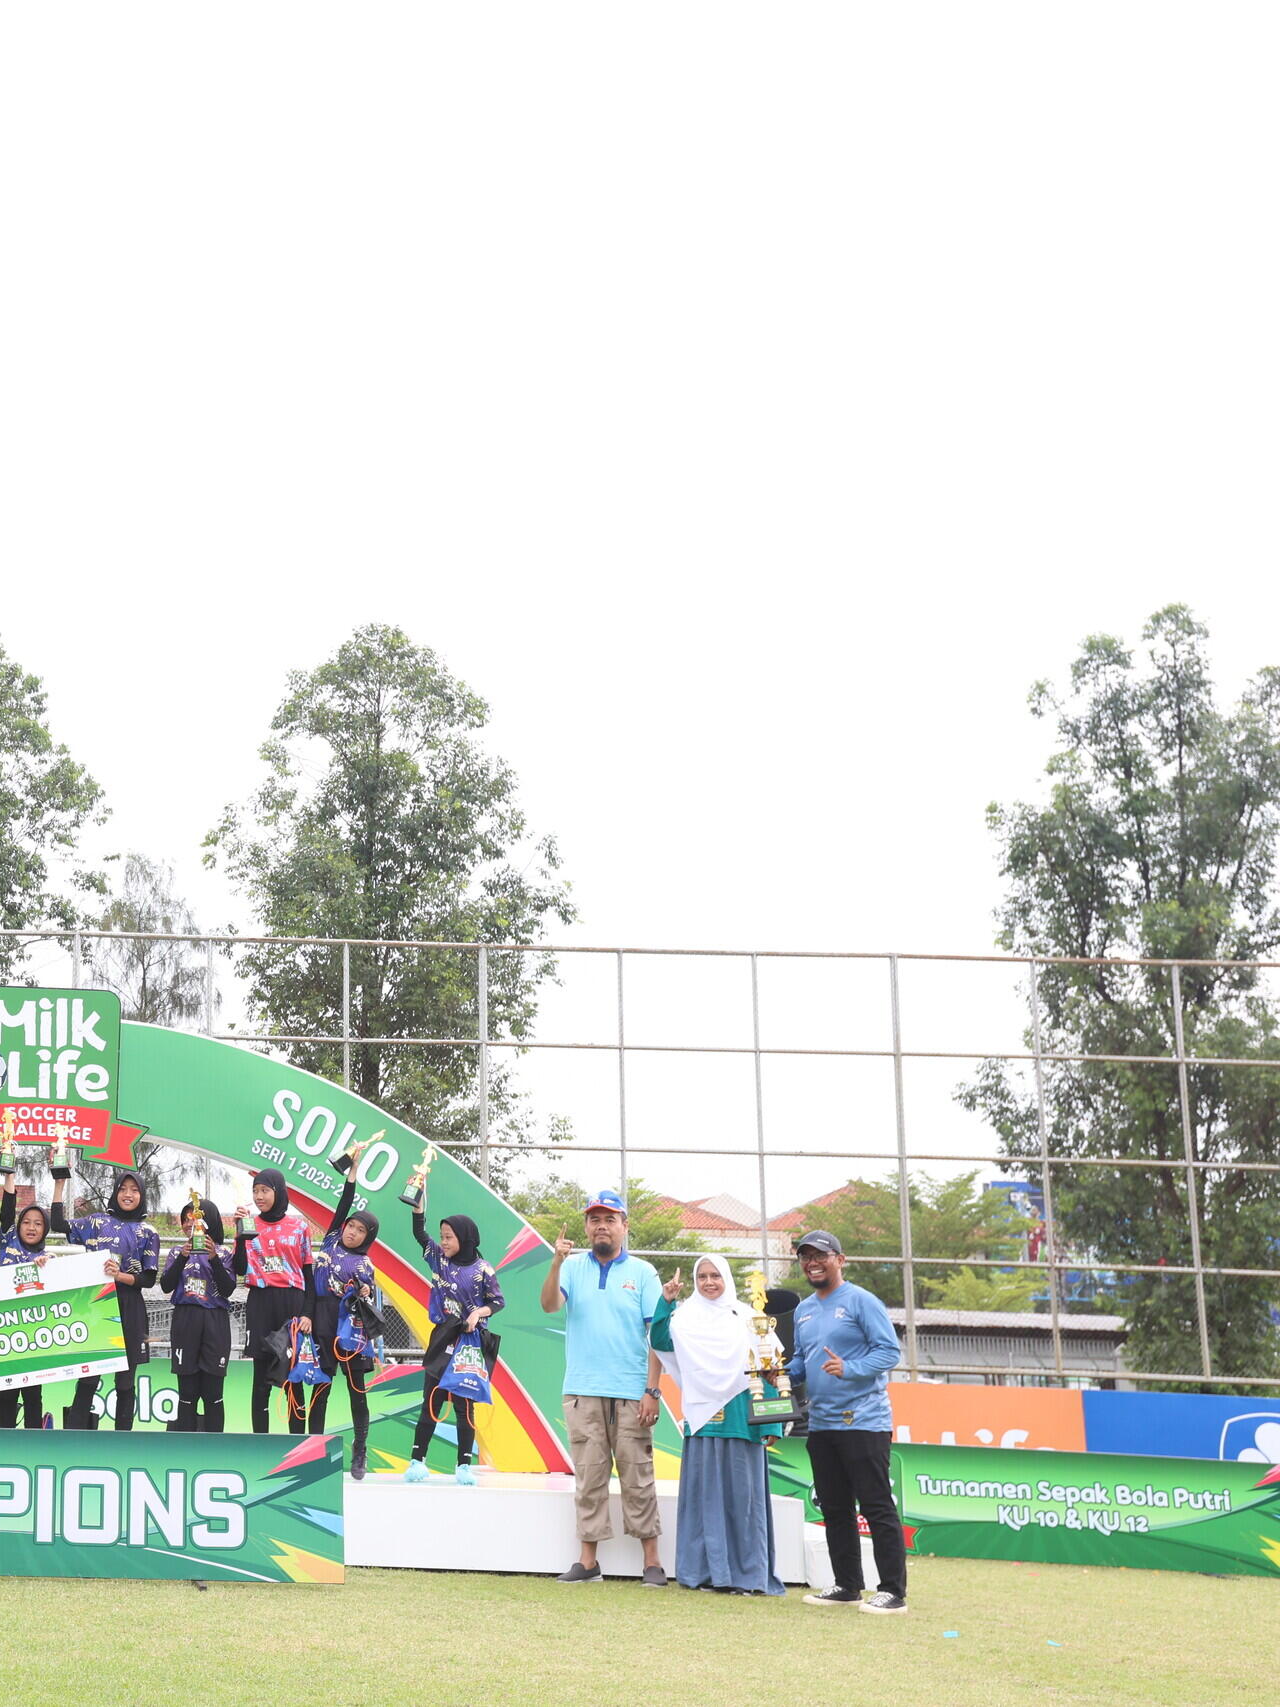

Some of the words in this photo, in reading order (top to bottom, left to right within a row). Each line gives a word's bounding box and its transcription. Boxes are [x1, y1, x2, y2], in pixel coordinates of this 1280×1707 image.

[7, 1048, 110, 1102] Life
[251, 1139, 287, 1165] SERI
[287, 1157, 298, 1171] 1
[297, 1162, 369, 1212] 2025-226
[21, 1306, 47, 1329] KU
[50, 1301, 73, 1320] 10
[175, 1349, 183, 1365] 4
[916, 1474, 1032, 1501] Turnamen
[1037, 1479, 1111, 1508] Sepak
[1115, 1484, 1167, 1508] Bola
[1172, 1487, 1232, 1513] Putri
[997, 1505, 1031, 1532] KU
[1036, 1511, 1058, 1529] 10
[1064, 1508, 1084, 1530] &
[1087, 1511, 1120, 1536] KU
[1124, 1515, 1150, 1534] 12
